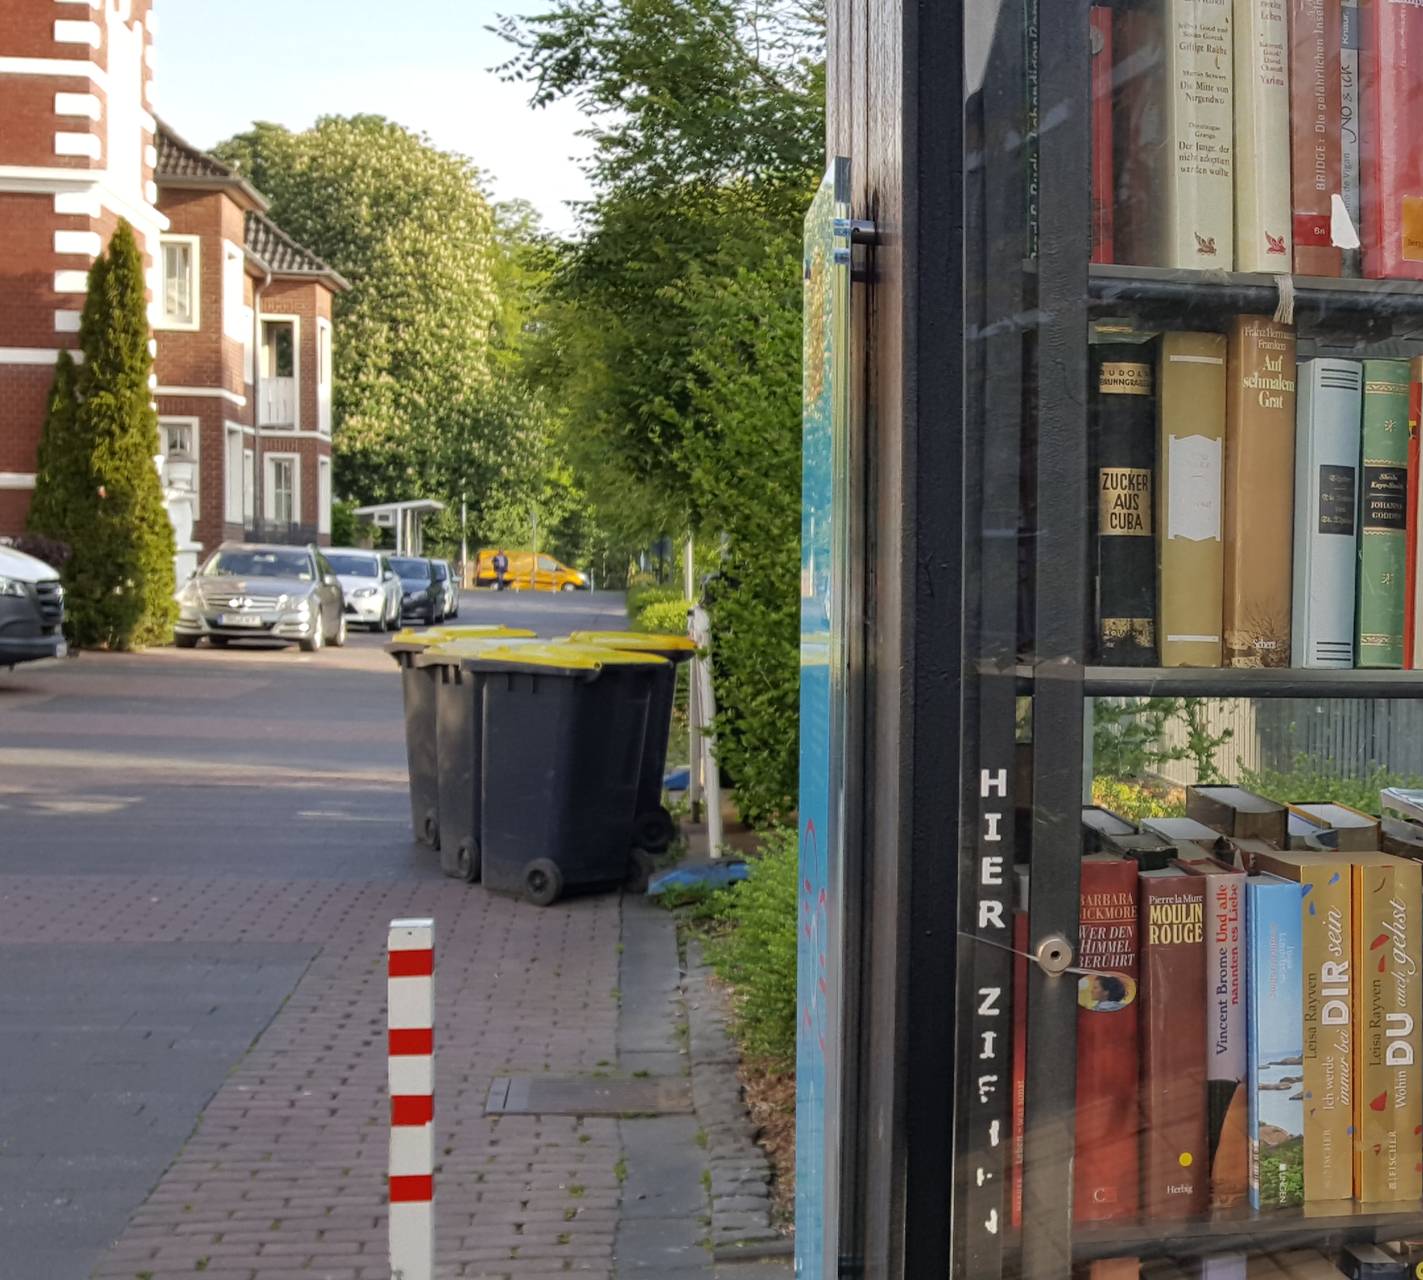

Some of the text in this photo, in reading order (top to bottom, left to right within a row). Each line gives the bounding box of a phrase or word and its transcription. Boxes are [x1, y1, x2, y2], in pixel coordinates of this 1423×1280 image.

[1262, 355, 1284, 373] Auf
[1242, 374, 1295, 392] schmalem
[1258, 391, 1284, 409] Grat
[1102, 472, 1149, 491] ZUCKER
[1113, 493, 1140, 510] AUS
[1110, 512, 1144, 531] CUBA
[1148, 895, 1174, 904] Pierre
[1175, 894, 1182, 904] la
[1080, 905, 1138, 919] ICKMORE
[1149, 904, 1203, 924] MOULIN
[1109, 926, 1134, 939] DEN
[1149, 923, 1203, 945] ROUGE
[1380, 897, 1417, 976] gehst
[1080, 939, 1132, 954] HIMMEL
[1229, 883, 1239, 1005] nannten es Liebe
[1216, 884, 1229, 1055] Vincent Brome Und alle
[1396, 969, 1408, 1008] auch
[1322, 905, 1351, 1106] immer bei DIR sein
[1304, 973, 1319, 1060] Leisa Rayven
[1368, 979, 1383, 1066] Leisa Rayven
[1386, 1012, 1414, 1066] DU
[1323, 1056, 1335, 1111] Ich werde
[1388, 1130, 1398, 1177] FISCHER
